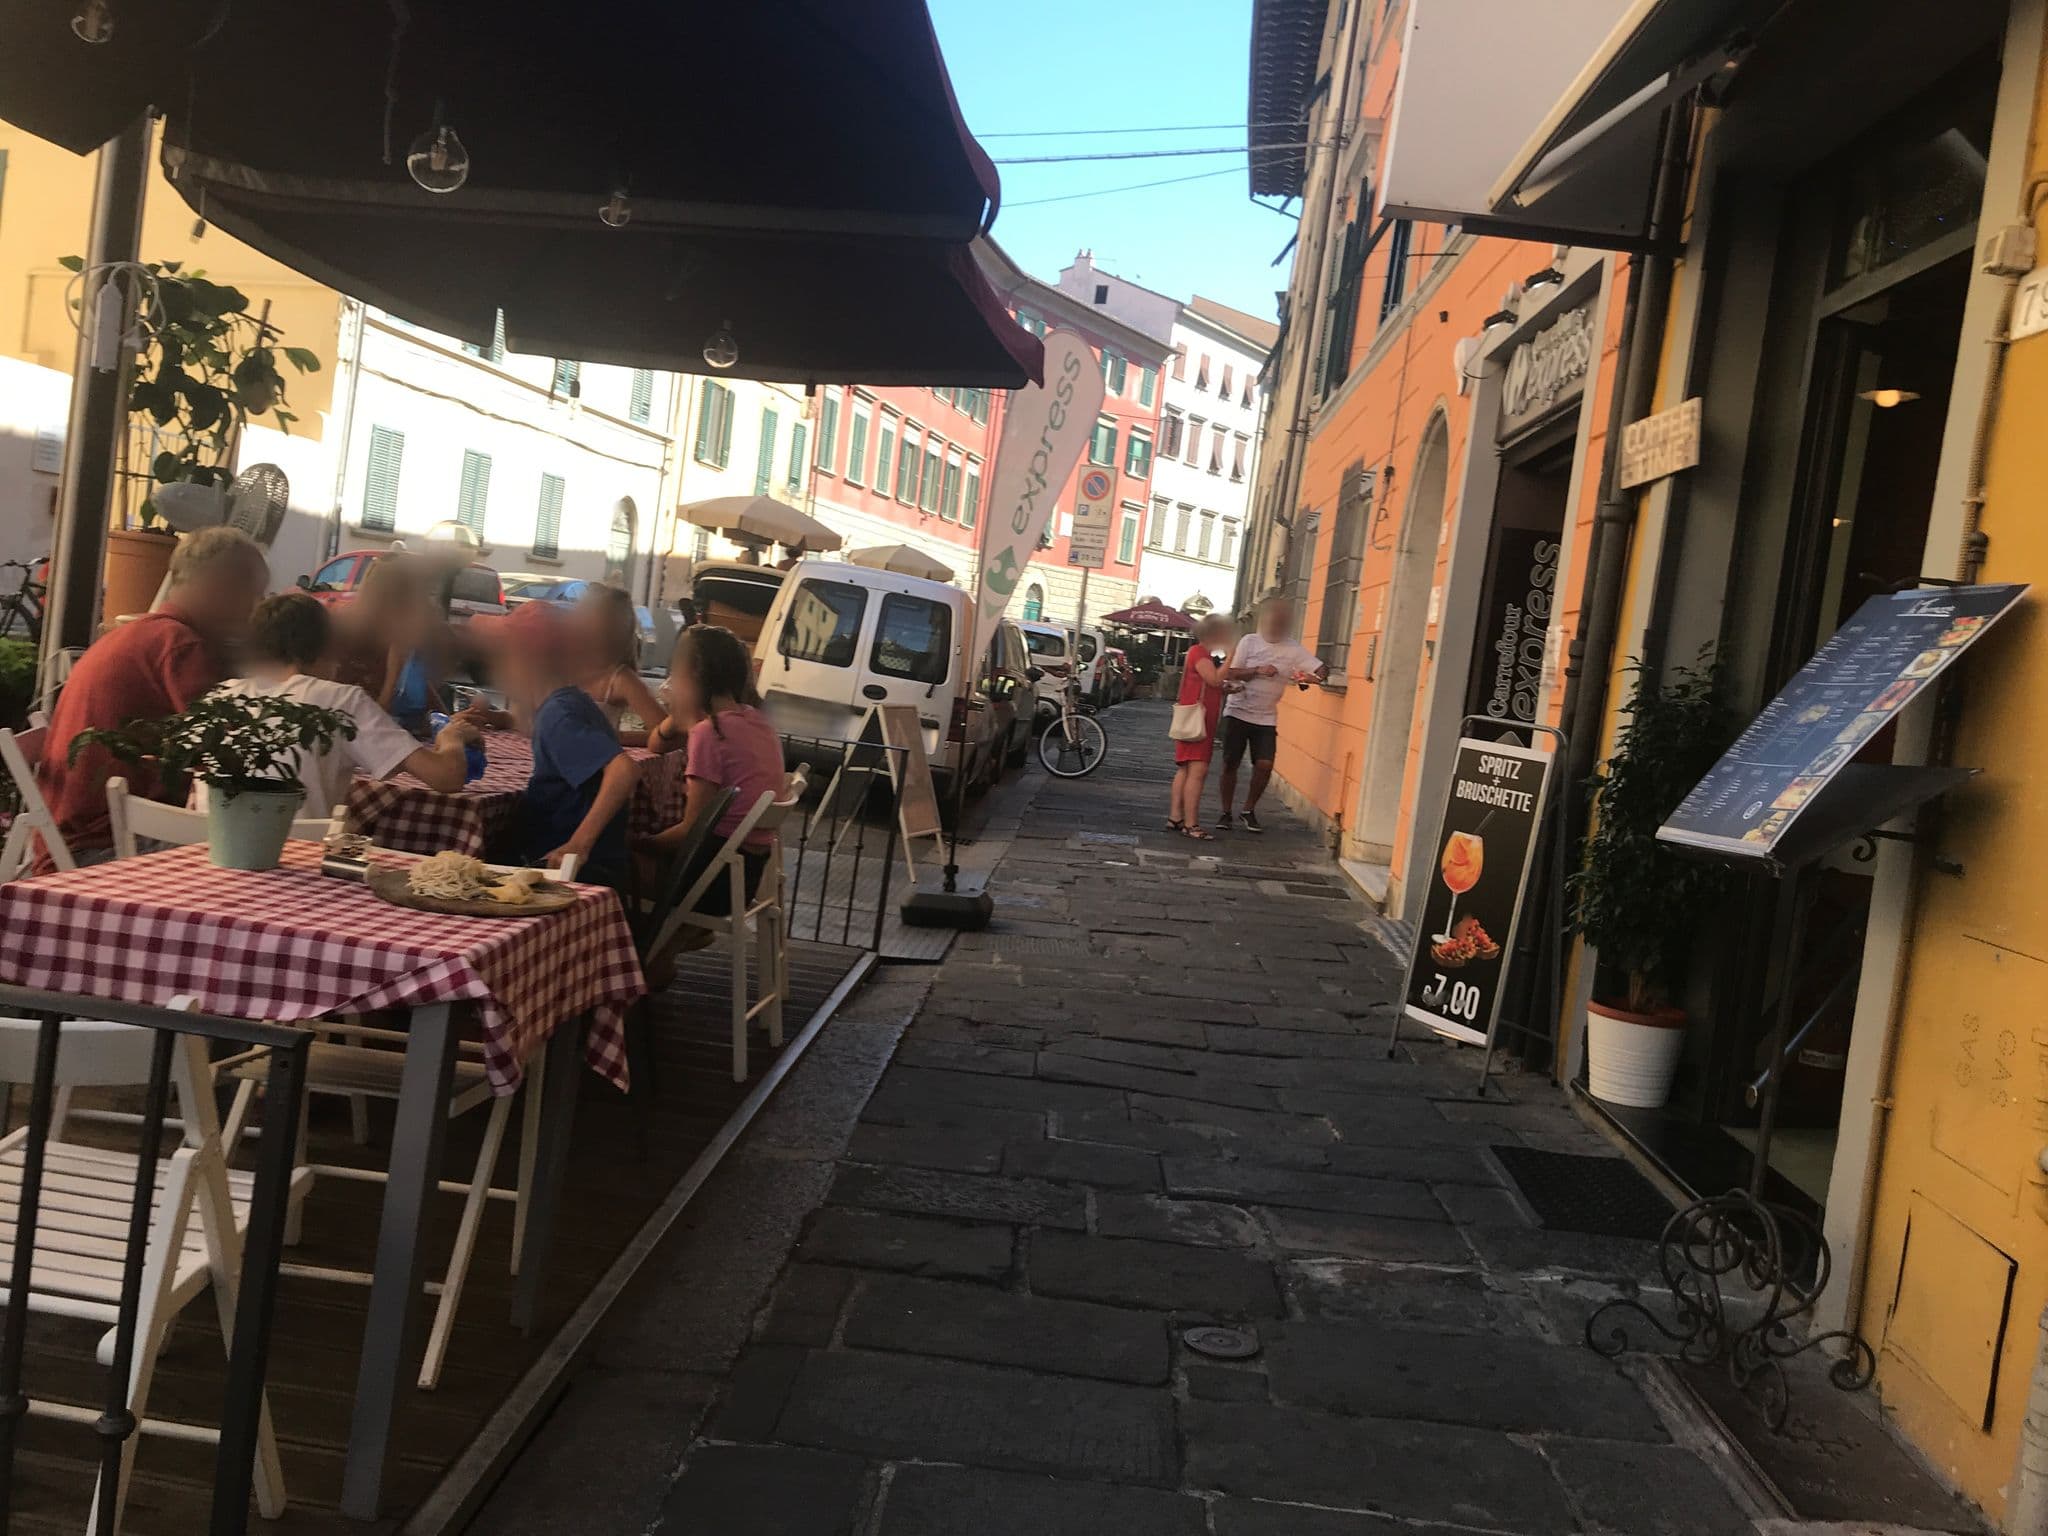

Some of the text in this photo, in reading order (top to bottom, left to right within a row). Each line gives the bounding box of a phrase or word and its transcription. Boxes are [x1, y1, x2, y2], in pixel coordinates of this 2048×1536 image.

[1011, 351, 1081, 536] express
[1627, 406, 1697, 455] COFFEE
[1634, 440, 1686, 480] TIME
[1512, 540, 1561, 721] express
[1487, 603, 1522, 718] Carrefour
[1478, 754, 1522, 780] SPRITZ
[1492, 776, 1500, 786] +
[1456, 779, 1533, 813] BRUSCHETTE
